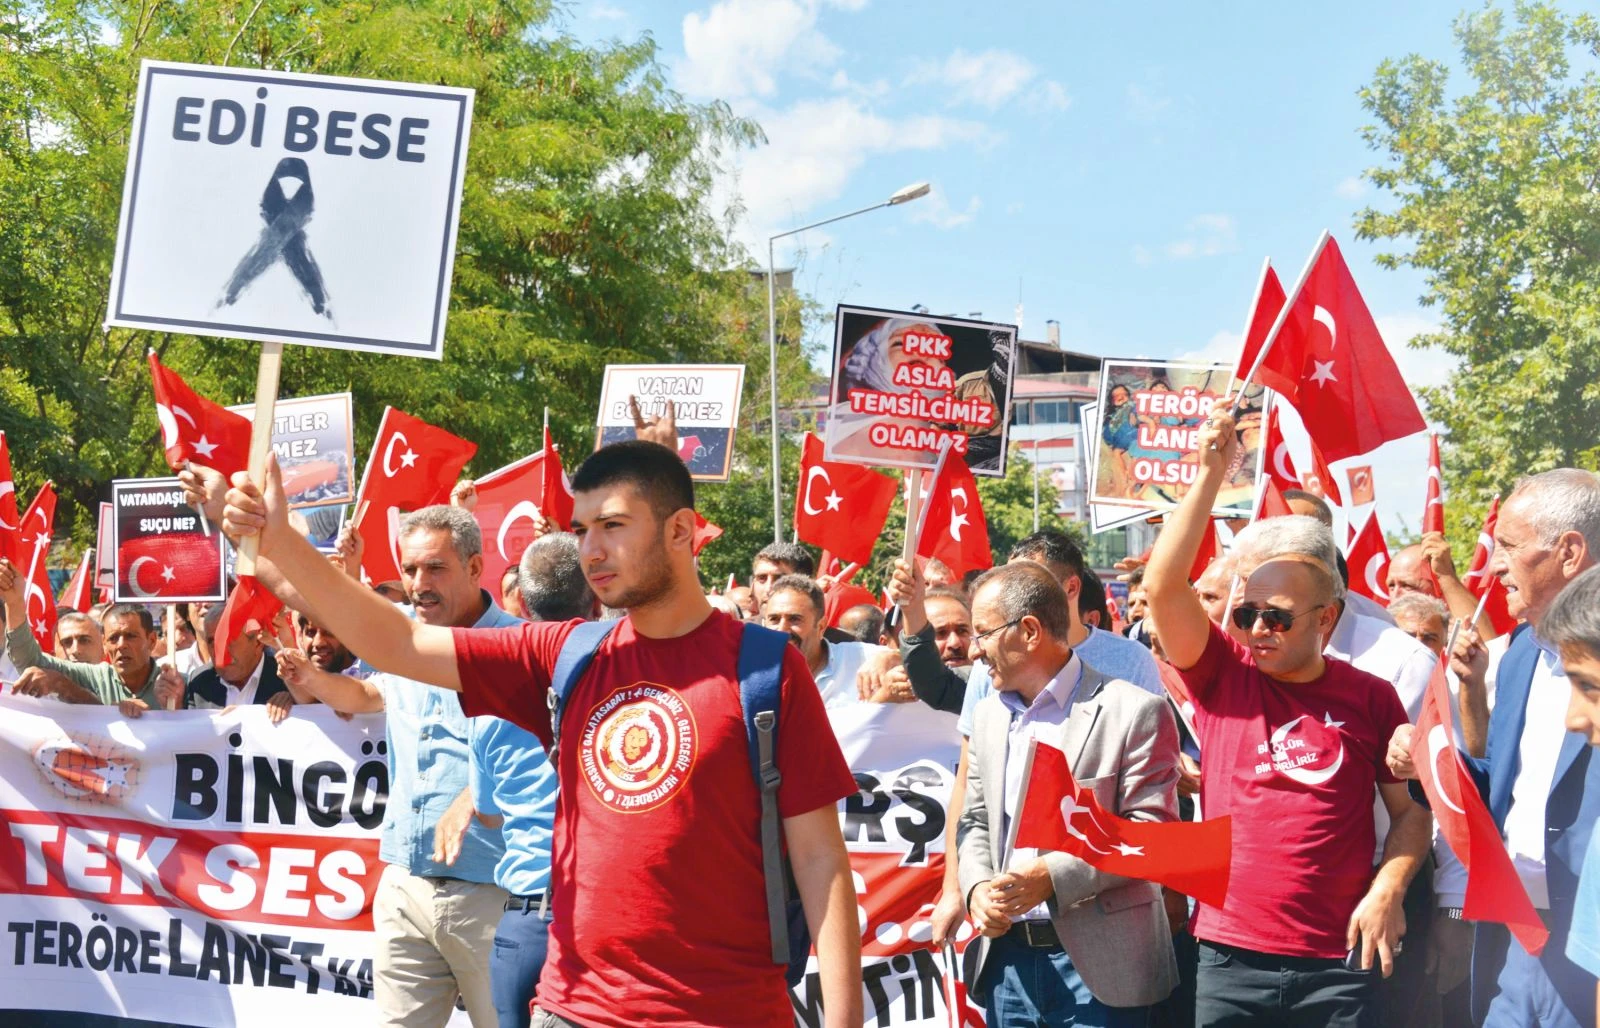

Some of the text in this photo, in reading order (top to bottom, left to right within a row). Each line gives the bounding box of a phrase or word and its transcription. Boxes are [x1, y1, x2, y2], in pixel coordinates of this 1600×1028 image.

[172, 87, 430, 163] EDİ BESE
[904, 335, 950, 357] PKK
[638, 377, 703, 396] VATAN
[895, 365, 951, 388] ASLA
[851, 391, 992, 424] TEMSİLCİMİZ
[1136, 389, 1213, 416] TERÖR
[272, 412, 329, 436] TLER
[272, 438, 318, 459] MEZ
[871, 426, 966, 453] OLAMAZ
[1140, 427, 1199, 450] LANE
[1135, 460, 1198, 484] OLSU
[140, 516, 196, 535] SUÇU NE?
[171, 731, 389, 831] BİNGÖ
[9, 821, 367, 921] TEK SES
[7, 912, 375, 1001] TERÖRE LANET KA
